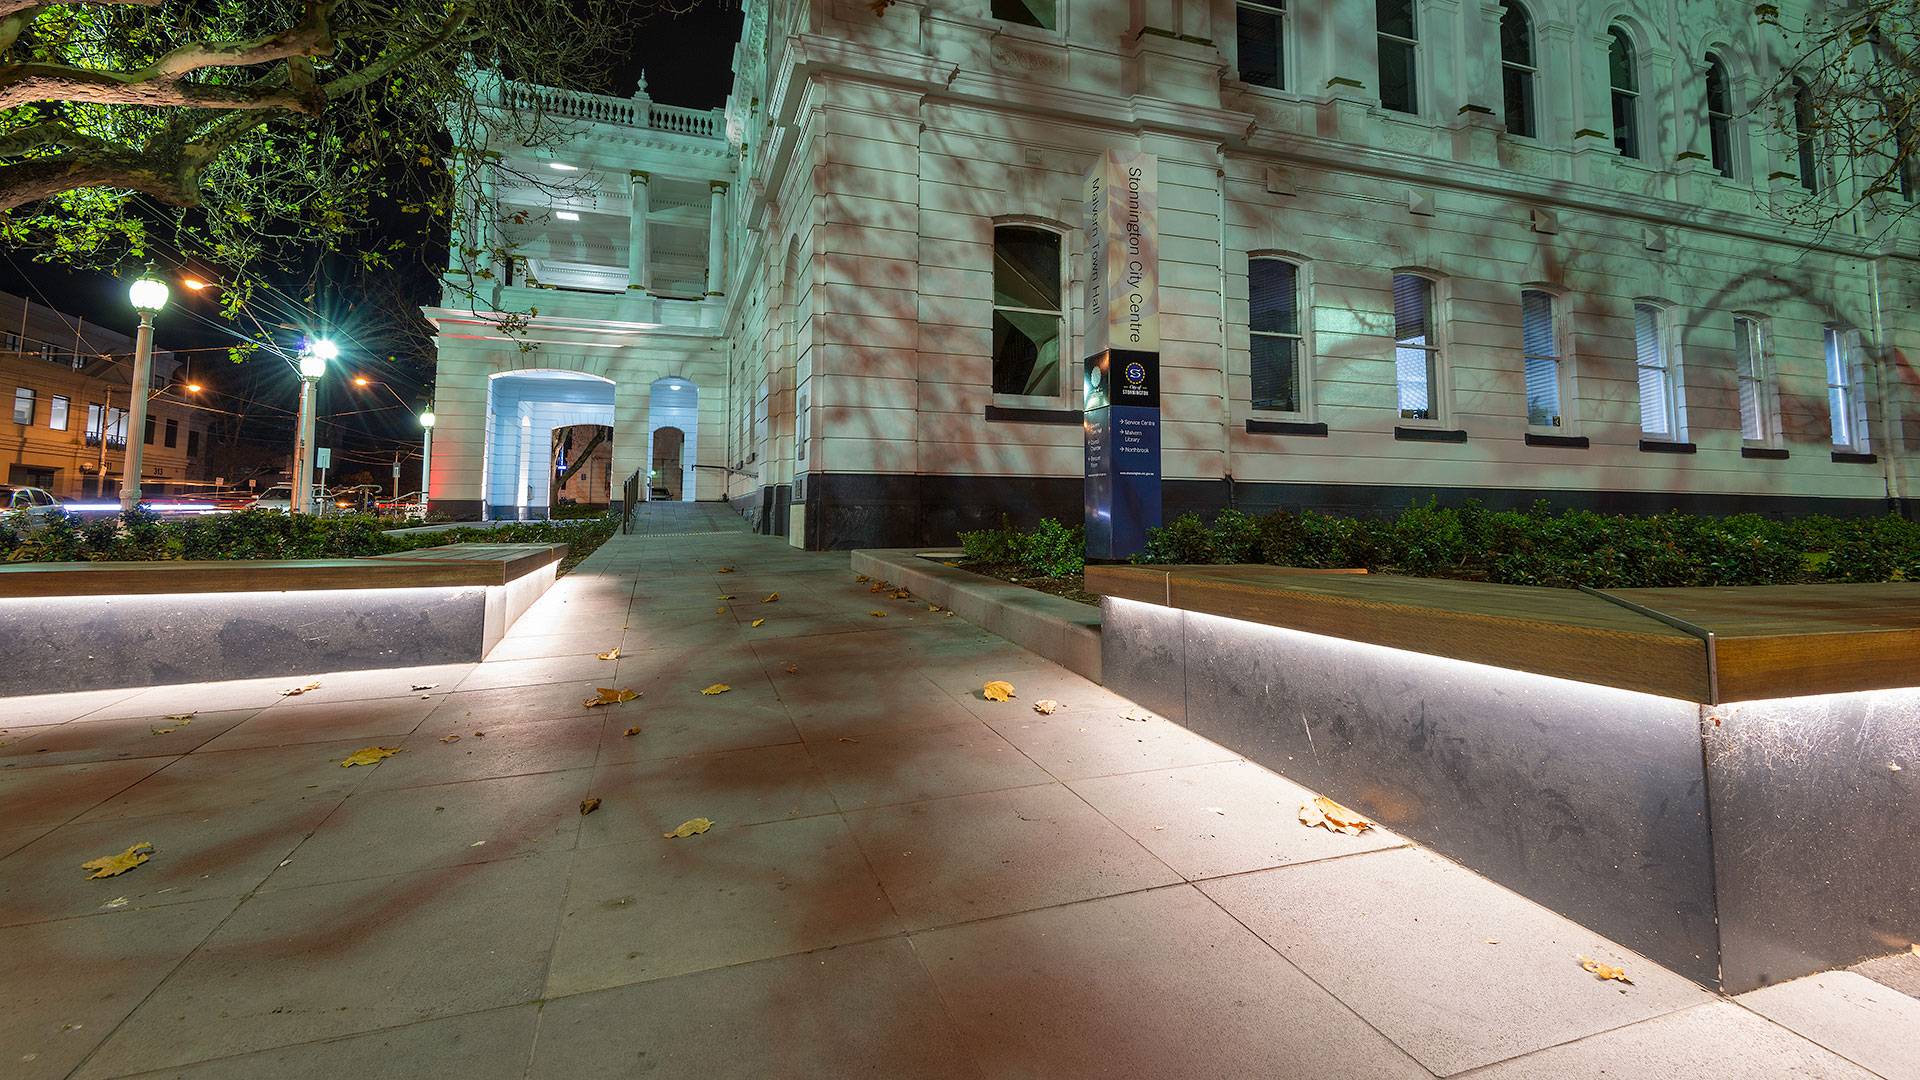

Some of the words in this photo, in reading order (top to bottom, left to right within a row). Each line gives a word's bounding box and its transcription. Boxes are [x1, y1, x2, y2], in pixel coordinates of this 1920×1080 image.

[1092, 177, 1100, 237] Malvern
[1127, 167, 1142, 255] Stonnington
[1092, 240, 1100, 281] Town
[1126, 260, 1143, 289] City
[1092, 285, 1100, 315] Hall
[1129, 293, 1143, 342] Centre
[1124, 436, 1140, 444] Library
[153, 467, 163, 475] 313
